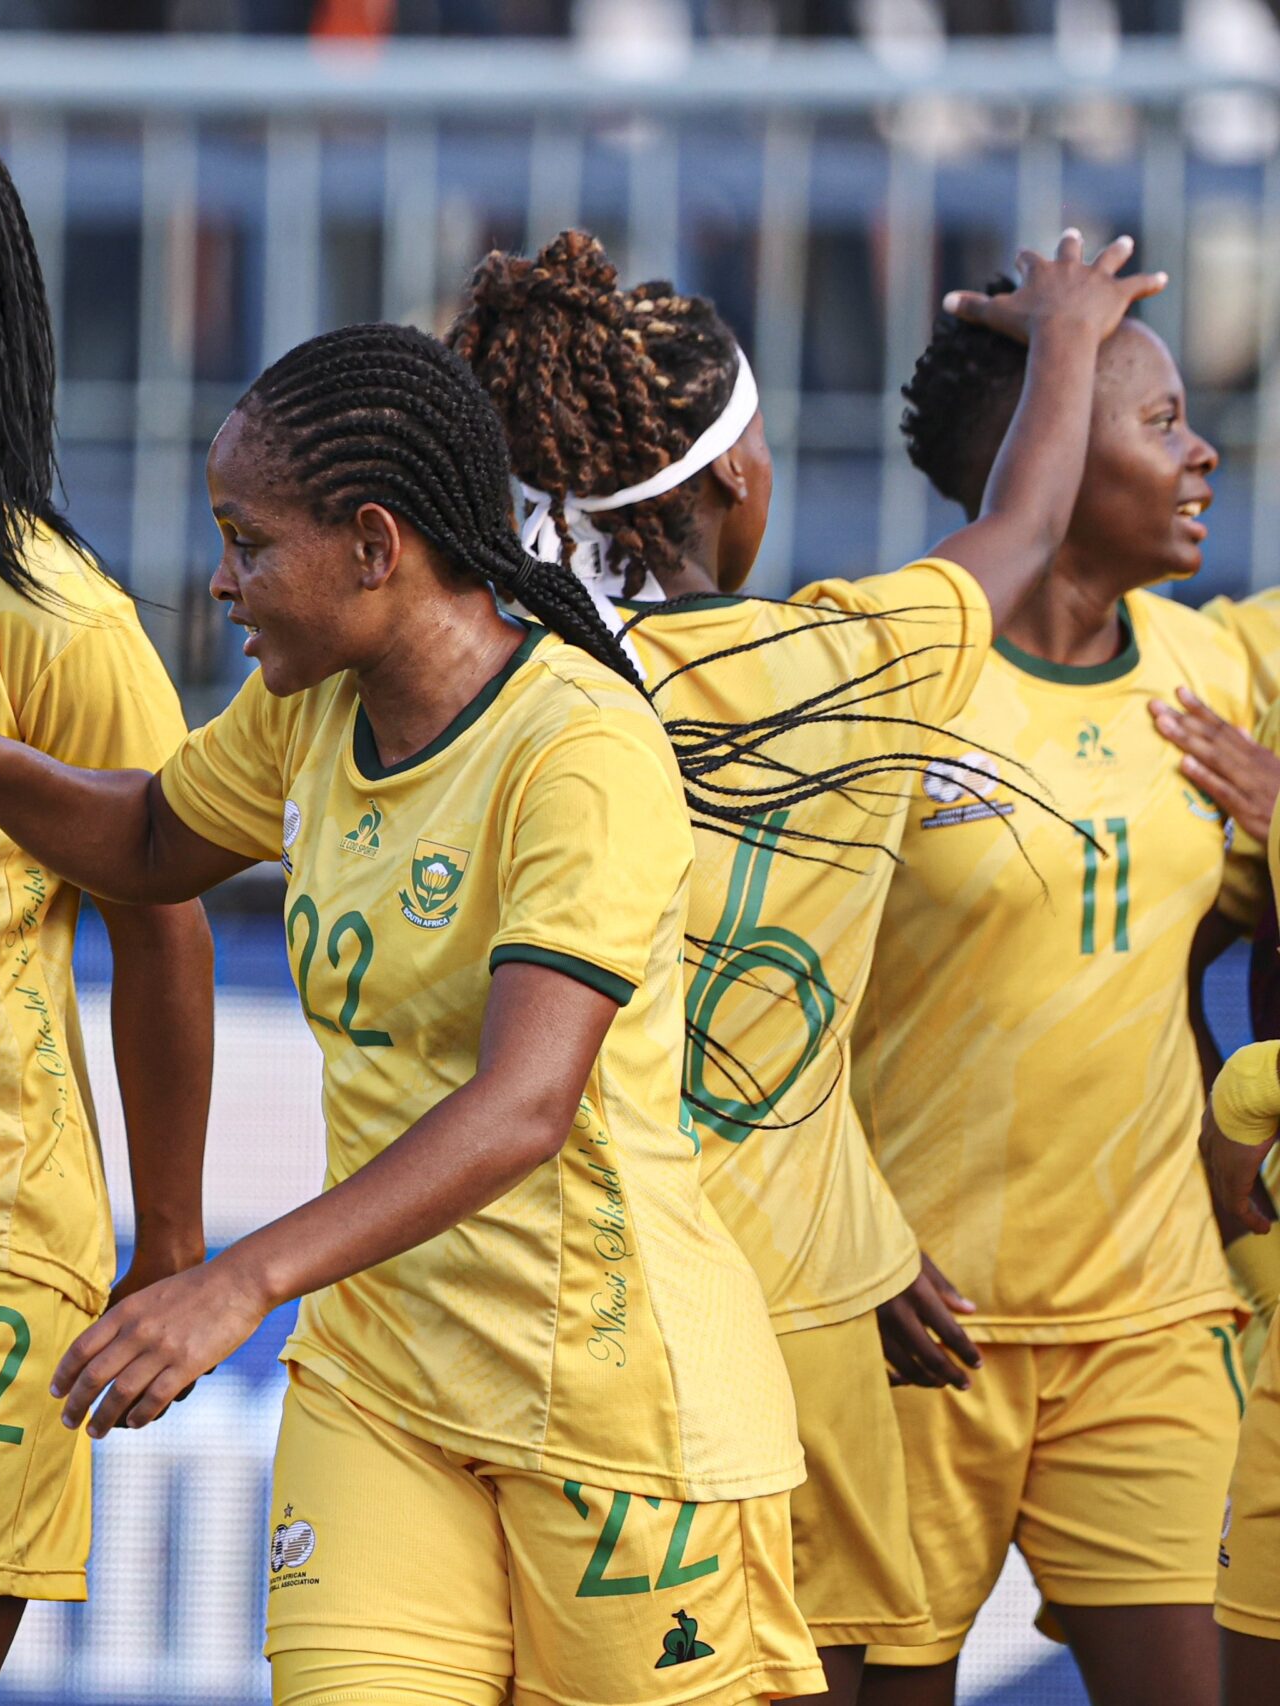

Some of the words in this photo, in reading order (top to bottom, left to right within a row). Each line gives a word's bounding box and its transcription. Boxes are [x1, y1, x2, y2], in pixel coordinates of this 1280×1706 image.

[403, 907, 423, 926] SOUTH
[422, 917, 449, 927] AFRICA
[1072, 817, 1130, 955] 11
[287, 894, 394, 1048] 22
[586, 1271, 627, 1368] Nkosi
[281, 1578, 320, 1588] ASSOCIATION
[282, 1571, 307, 1581] AFRICAN
[563, 1479, 720, 1598] 22
